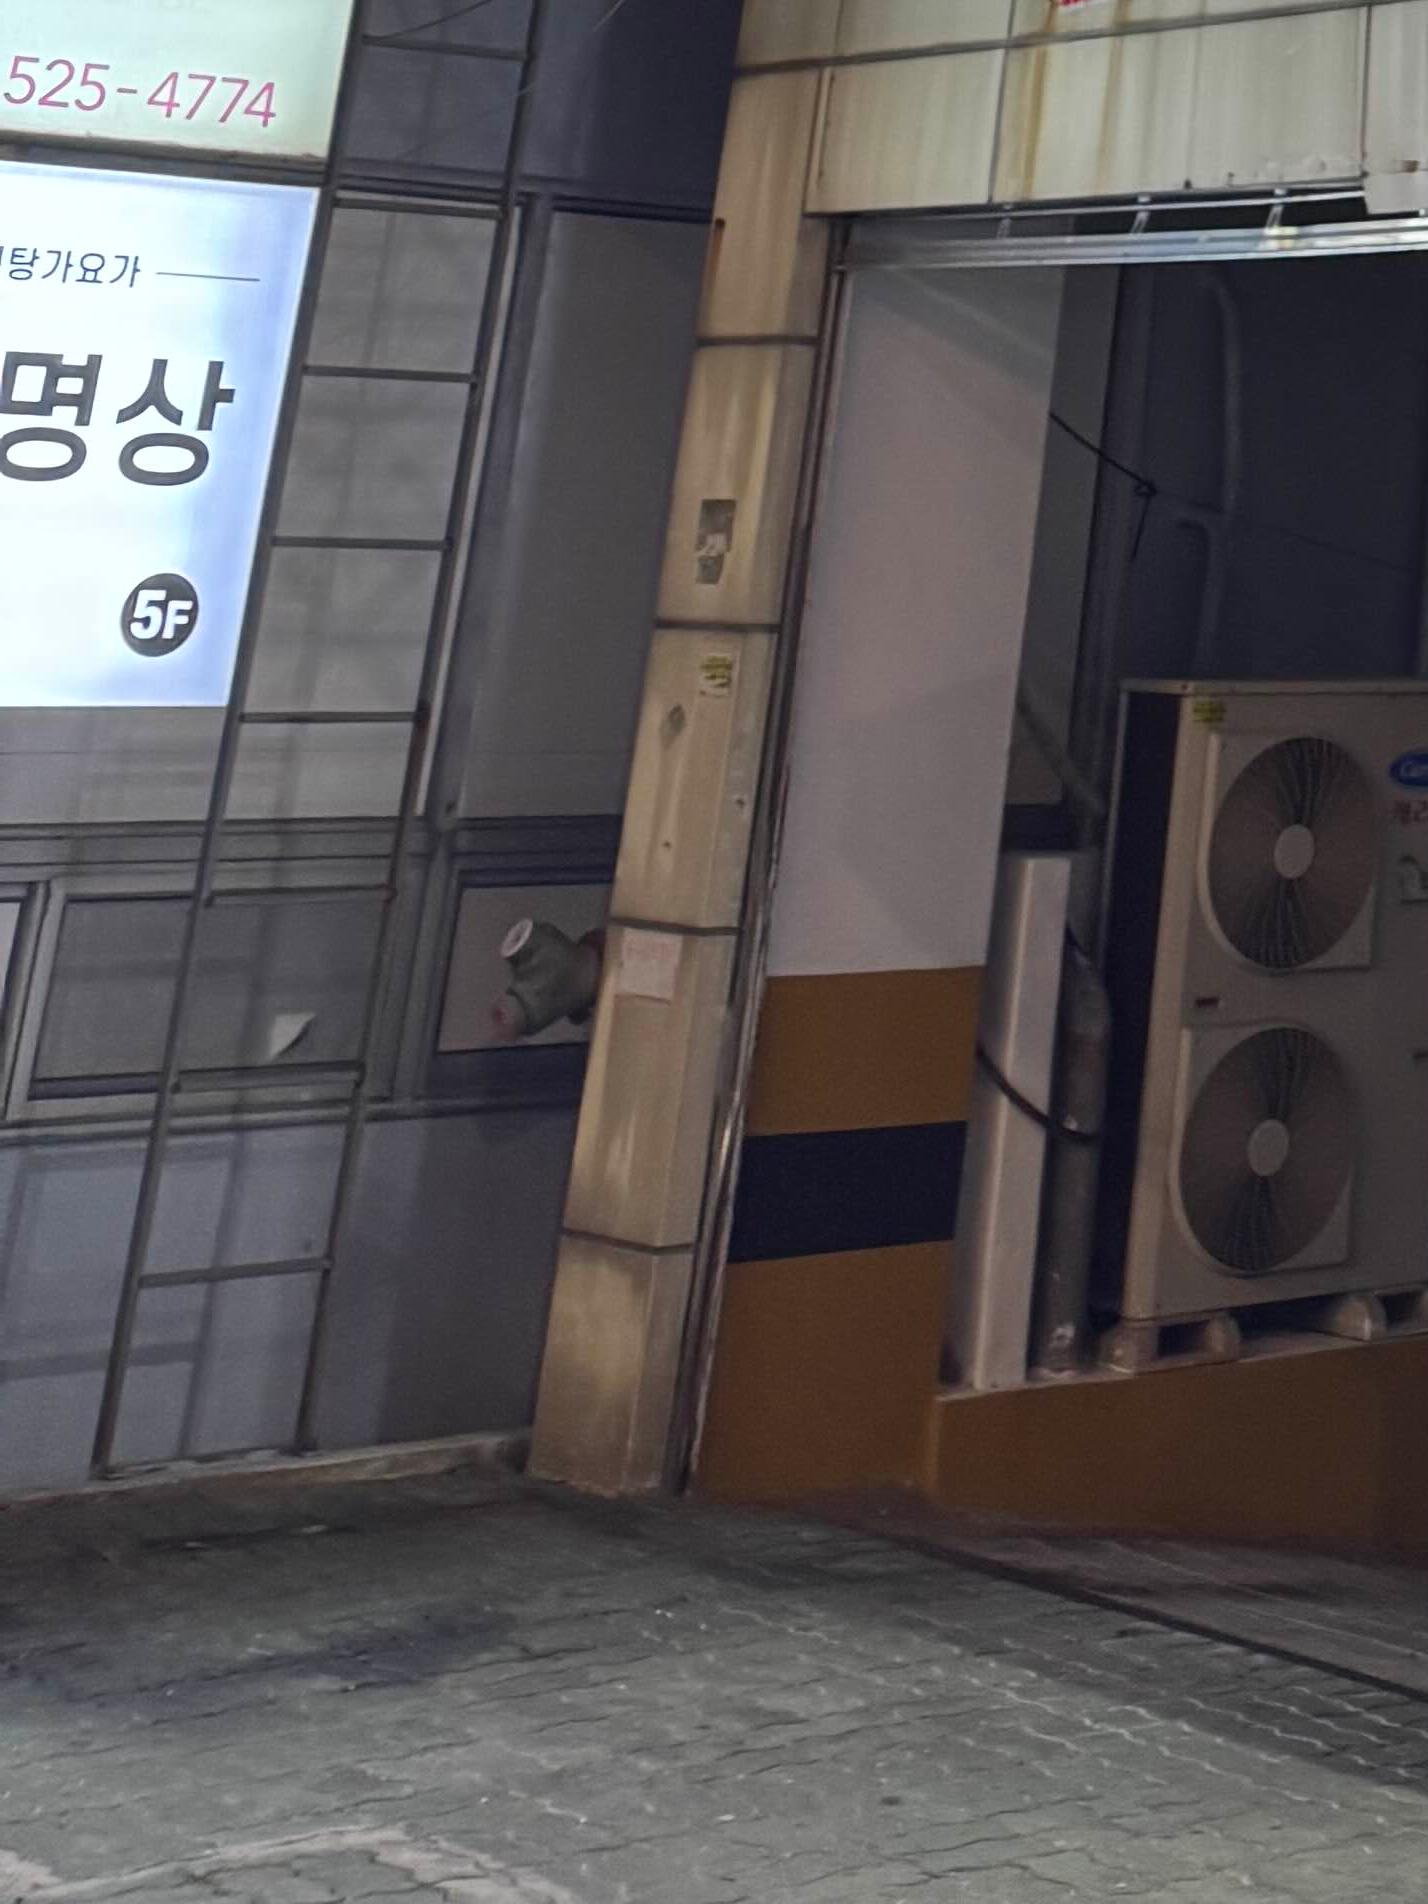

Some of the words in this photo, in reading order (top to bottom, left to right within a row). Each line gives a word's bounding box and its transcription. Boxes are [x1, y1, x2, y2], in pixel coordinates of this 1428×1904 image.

[2, 55, 277, 129] 525-4774
[0, 245, 142, 288] 탕가요가
[0, 351, 236, 488] 명상
[130, 589, 194, 641] 5F
